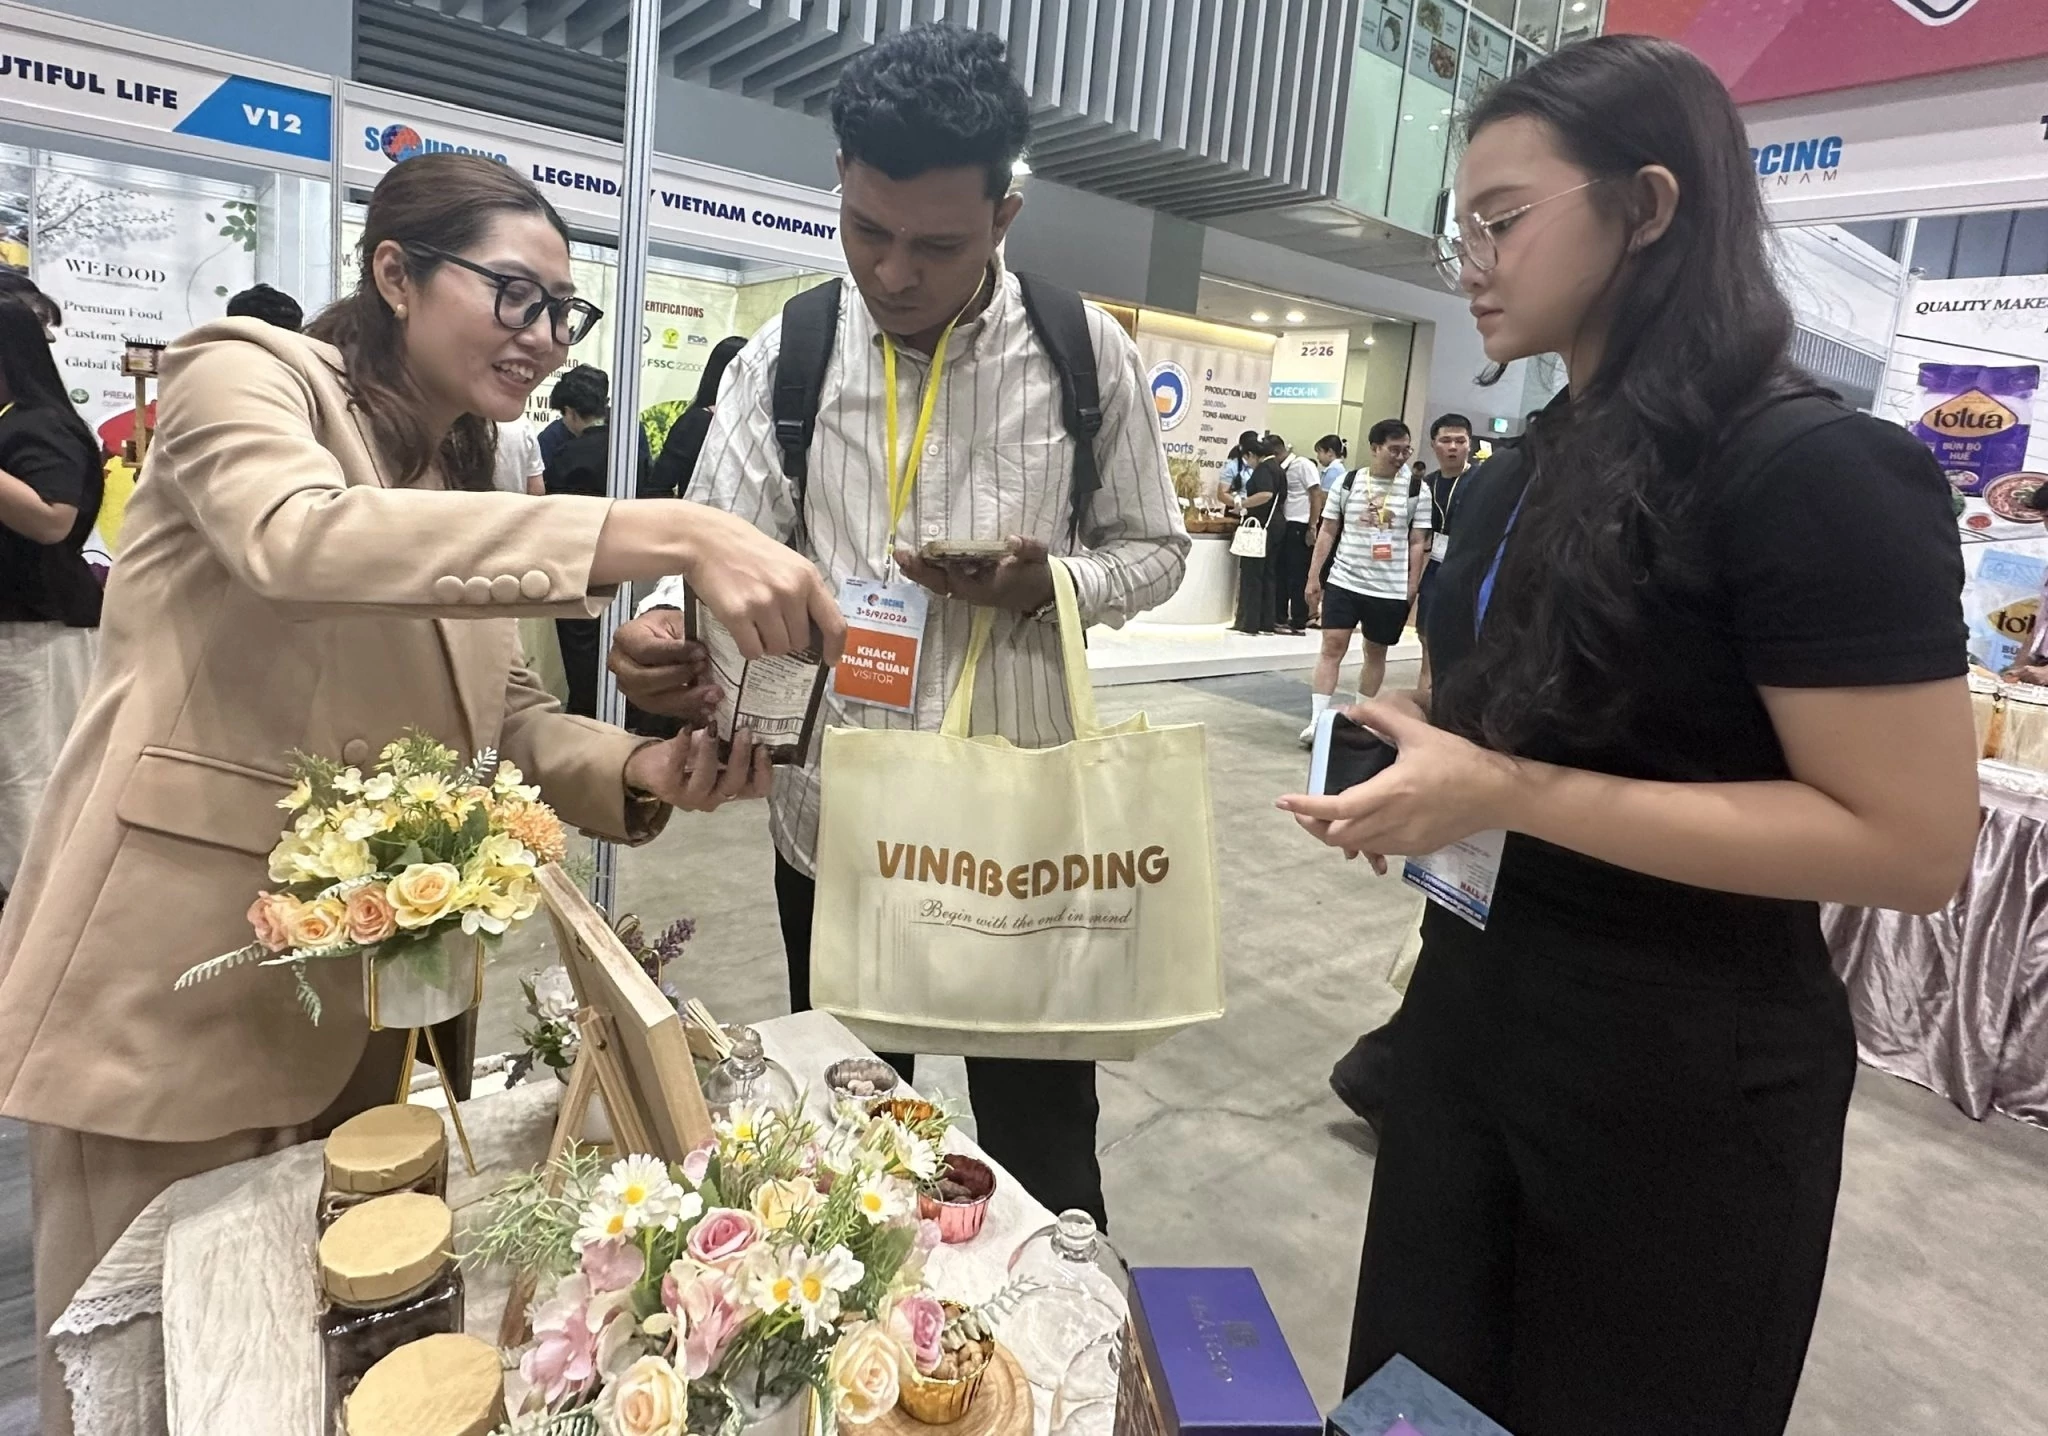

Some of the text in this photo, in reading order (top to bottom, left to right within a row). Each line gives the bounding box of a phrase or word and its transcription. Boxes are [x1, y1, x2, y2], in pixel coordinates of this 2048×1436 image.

[117, 79, 178, 110] LIFE
[242, 103, 302, 135] V12
[661, 190, 746, 223] VIETNAM
[752, 210, 837, 241] COMPANY
[64, 300, 164, 321] Premium Food
[1915, 299, 1991, 315] QUALITY
[64, 327, 116, 342] Custom
[65, 357, 107, 371] Global
[647, 358, 675, 370] FSSC
[1206, 369, 1213, 381] 9
[1204, 385, 1240, 397] PRODUCTION
[1241, 388, 1257, 400] LINES
[1273, 386, 1318, 397] CHECK-IN
[1202, 410, 1247, 422] TONS ANNUALLY
[1199, 435, 1229, 445] PARTNERS
[856, 607, 908, 624] 3-5/9/2026
[841, 654, 910, 676] THAM QUAN
[851, 668, 895, 685] VISITOR
[877, 840, 1170, 900] VINABEDDING
[920, 899, 972, 926] Begin
[976, 915, 1008, 930] with
[1012, 914, 1034, 930] the
[1068, 909, 1084, 922] in
[1089, 908, 1133, 925] mind
